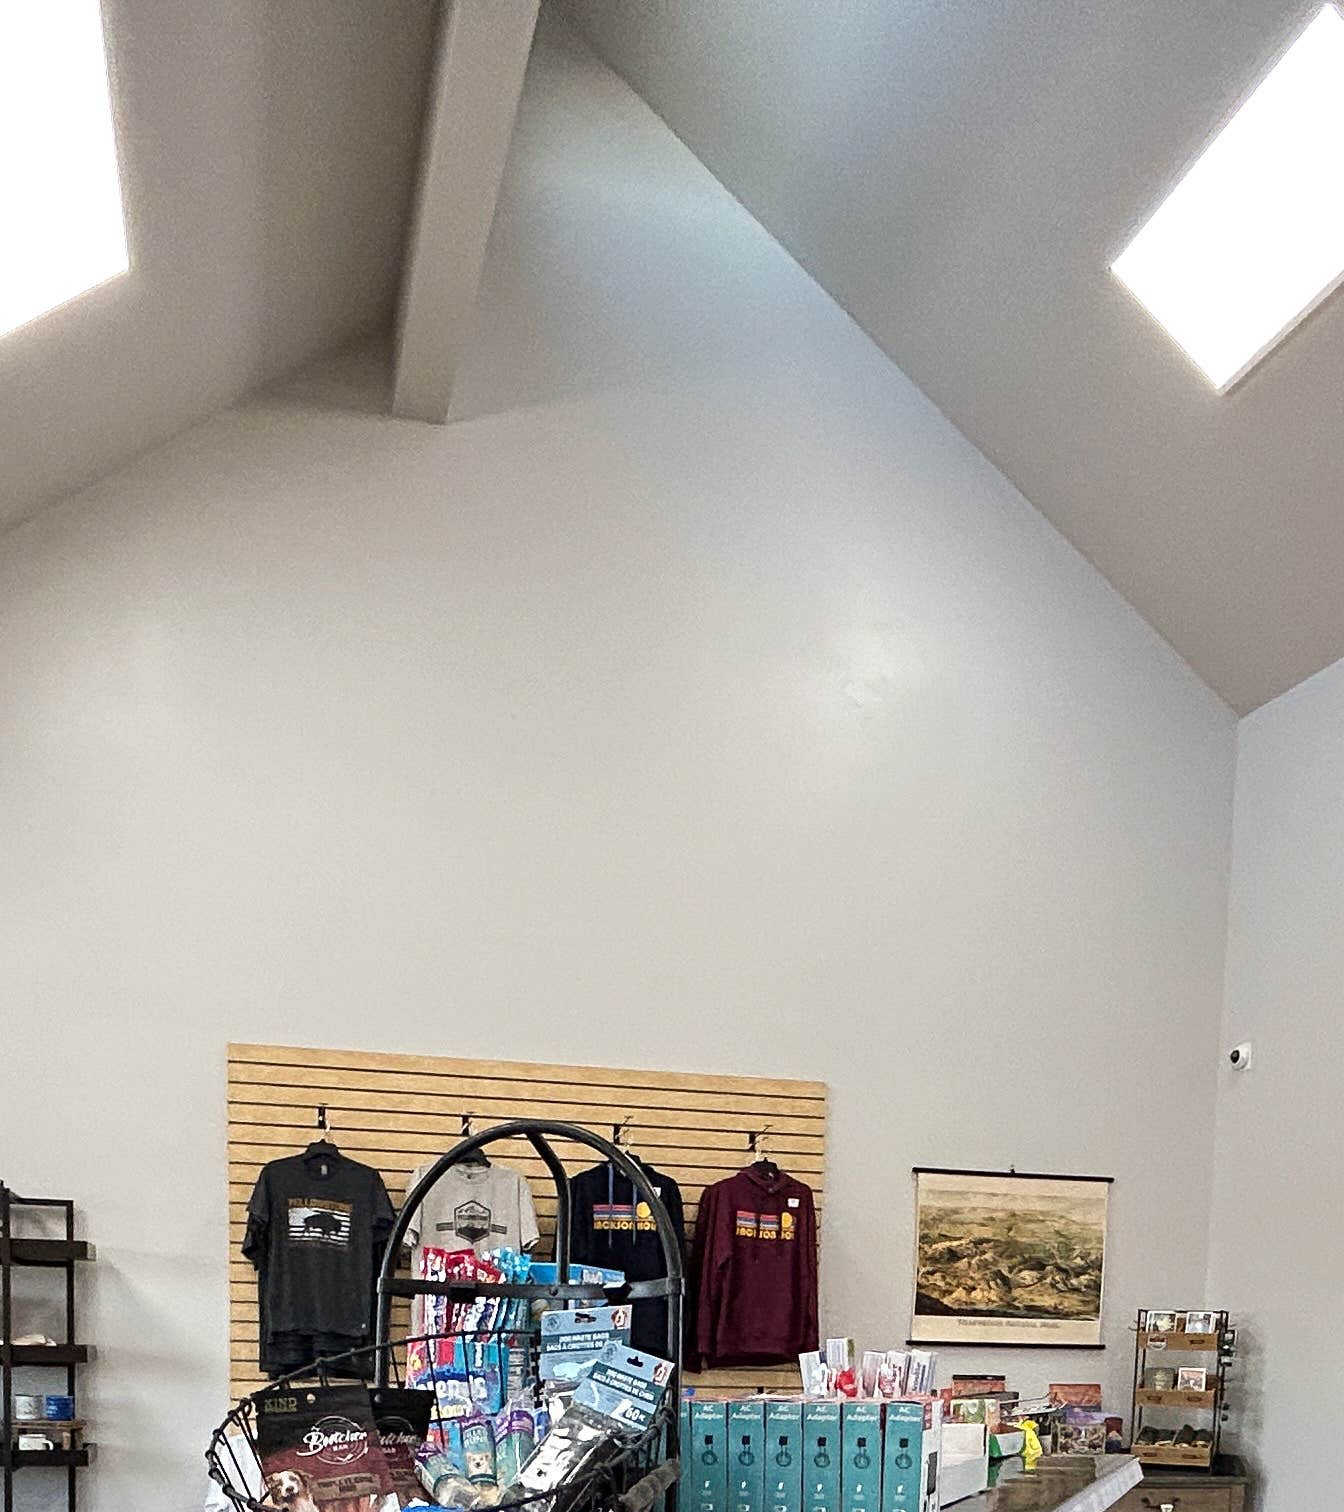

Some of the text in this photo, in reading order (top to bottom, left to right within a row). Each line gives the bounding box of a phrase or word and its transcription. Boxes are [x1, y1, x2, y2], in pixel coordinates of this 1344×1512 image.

[593, 1219, 656, 1231] JACKSON HOL
[694, 1412, 723, 1420] Adapter
[731, 1412, 761, 1421] Adapter
[769, 1412, 800, 1421] Adapter
[806, 1413, 838, 1421] Adapter
[846, 1414, 878, 1422] Adapter
[889, 1414, 921, 1422] Adapter
[297, 1430, 368, 1456] Butcher
[377, 1431, 421, 1446] utcher
